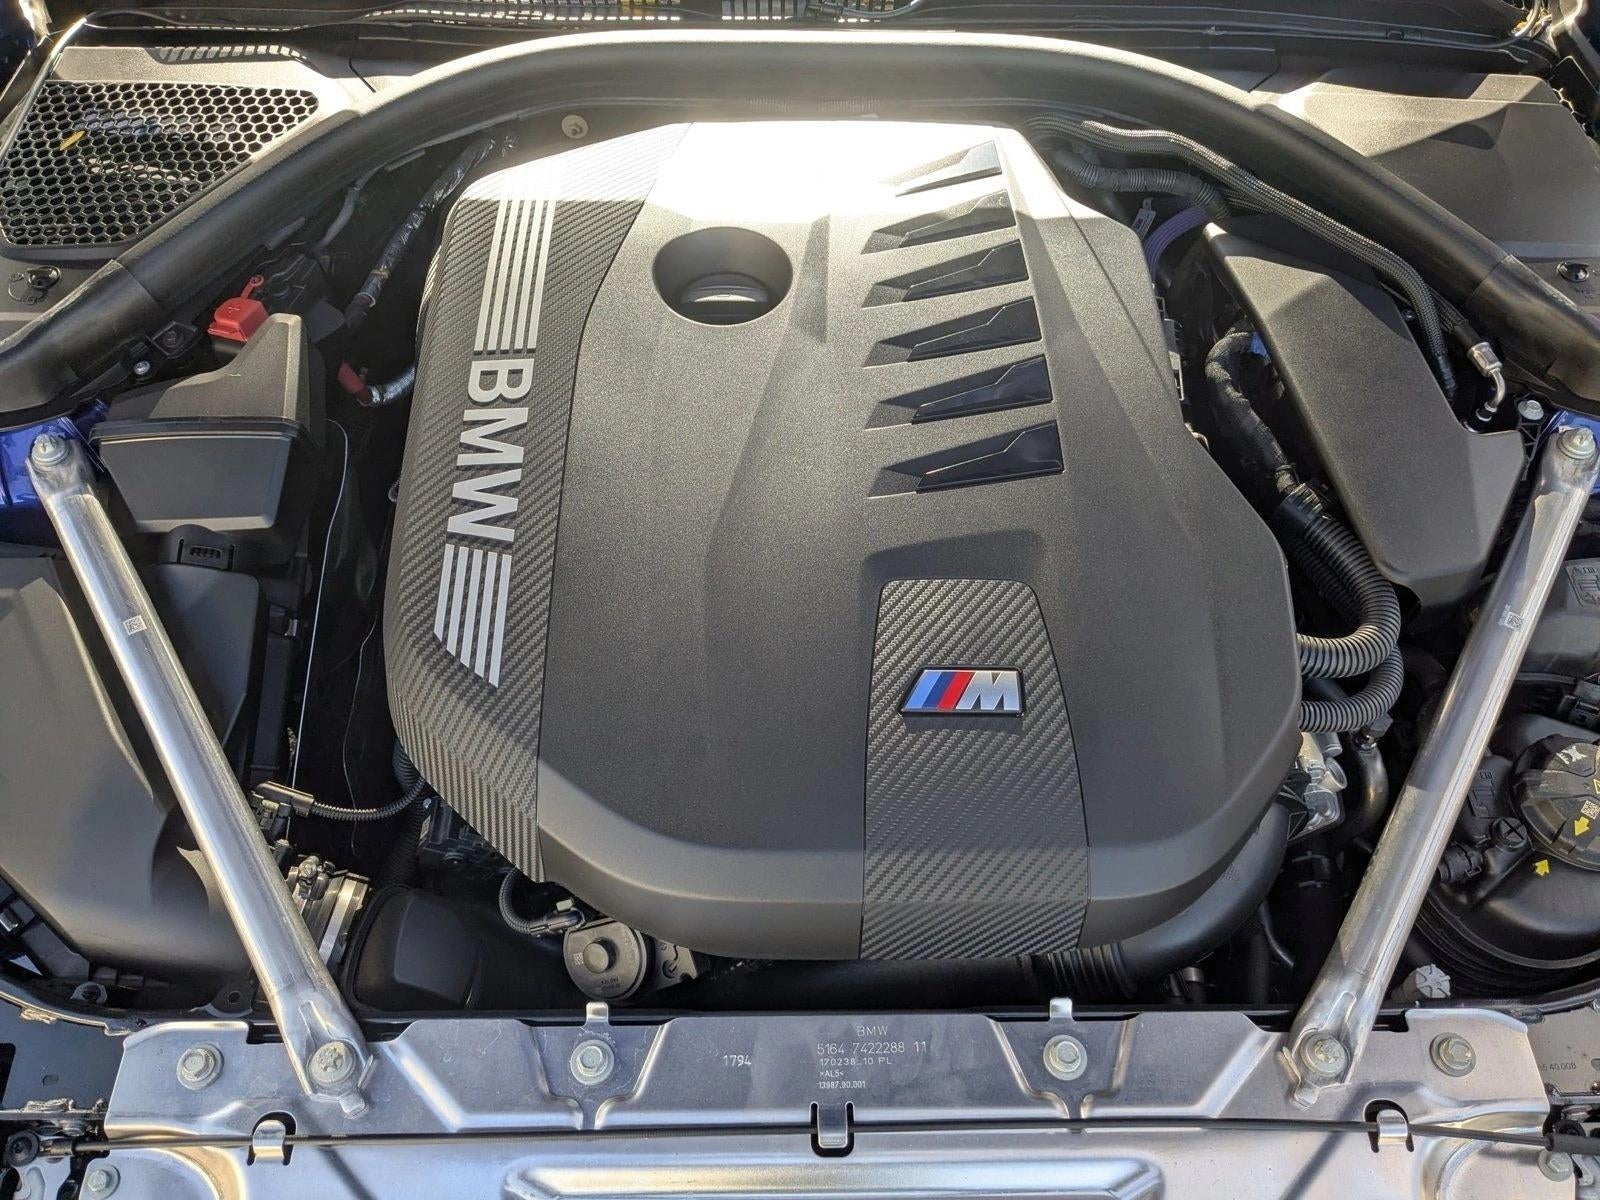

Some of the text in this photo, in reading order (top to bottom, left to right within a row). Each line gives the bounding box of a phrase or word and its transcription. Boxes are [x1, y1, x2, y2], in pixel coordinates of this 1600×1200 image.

[447, 358, 535, 542] BMW
[955, 670, 1020, 711] M
[856, 1025, 889, 1037] BMW
[817, 1041, 927, 1055] 5164 7422288 11
[722, 1054, 752, 1067] 1794
[878, 1056, 892, 1065] PL
[818, 1080, 866, 1089] 13987.90.001
